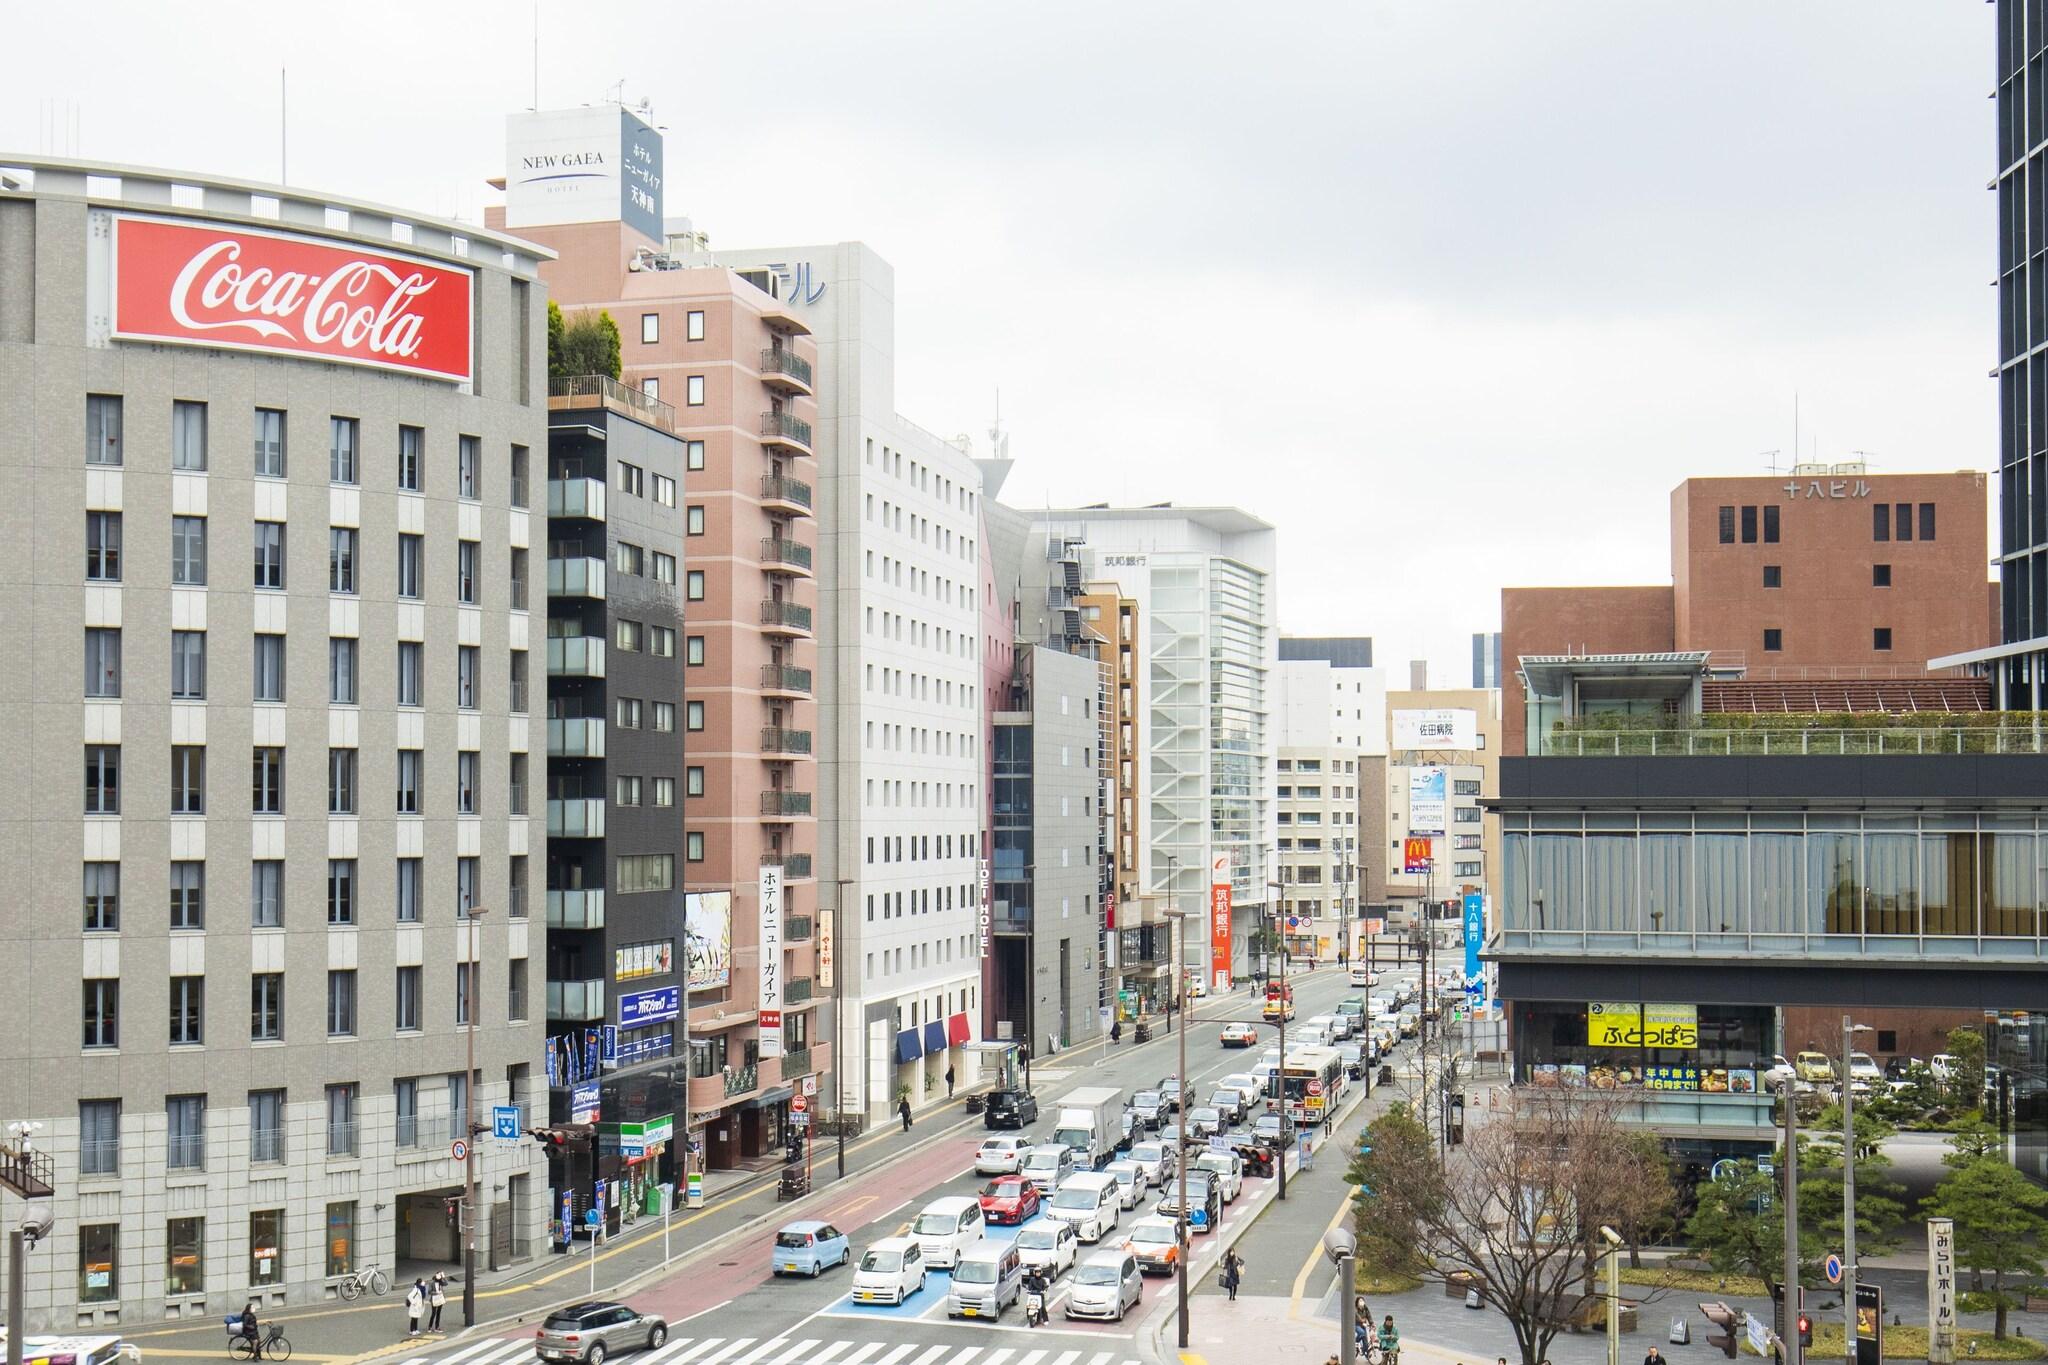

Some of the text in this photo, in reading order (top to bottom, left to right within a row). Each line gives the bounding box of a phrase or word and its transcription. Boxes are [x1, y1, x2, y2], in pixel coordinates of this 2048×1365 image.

[523, 151, 604, 169] NEW GAEA
[633, 143, 652, 164] ホテル
[624, 158, 661, 190] ニューガイア
[170, 240, 437, 357] Coca-Cola
[1783, 479, 1871, 499] 十八ビル
[1420, 723, 1453, 736] 佐田病院
[980, 859, 989, 958] TOEI HOTEL
[1215, 889, 1229, 938] 筑邦銀行
[1468, 902, 1479, 942] 十八銀行
[764, 872, 776, 1005] ホテルニューガイア
[1646, 1067, 1697, 1079] 年中無休
[1937, 1235, 1950, 1319] みらいホール
